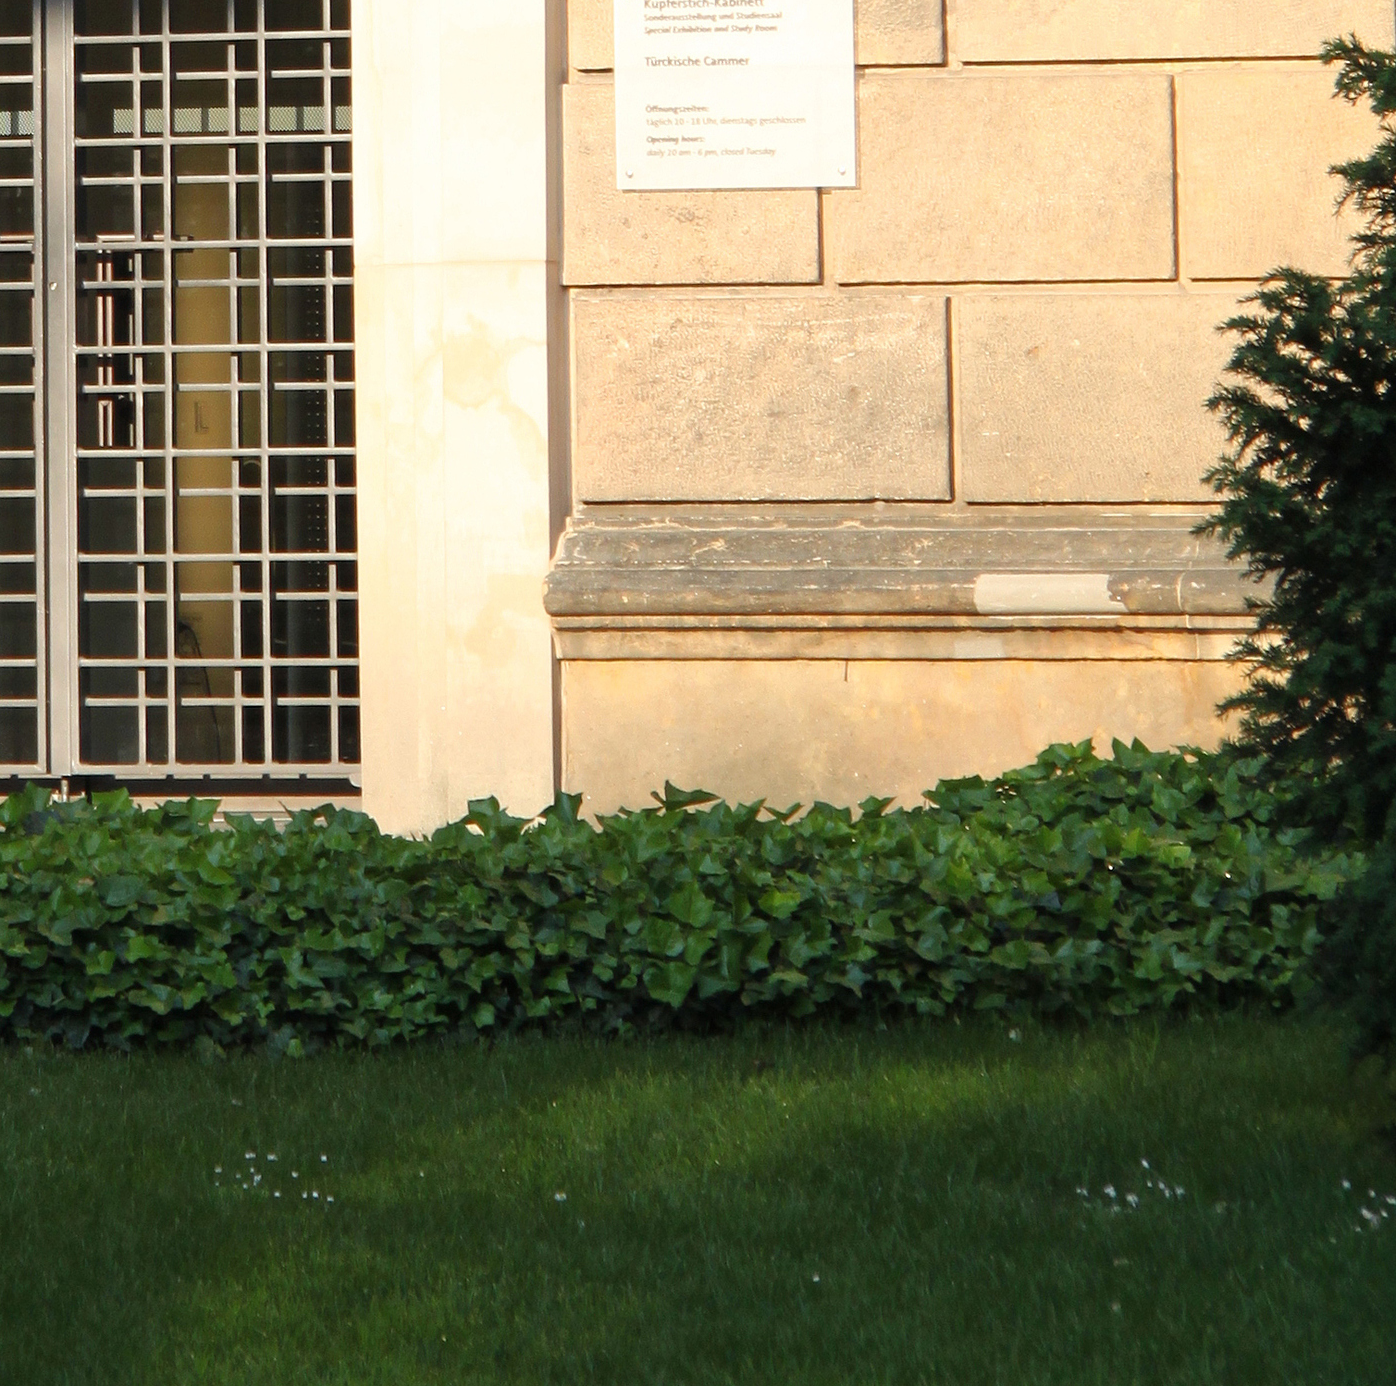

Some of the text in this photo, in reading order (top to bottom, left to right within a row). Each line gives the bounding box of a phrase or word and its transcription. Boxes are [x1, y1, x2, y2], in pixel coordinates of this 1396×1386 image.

[719, 12, 734, 20] und
[714, 25, 729, 33] and
[731, 24, 753, 34] Study
[644, 55, 750, 67] Türckische Cammer
[759, 116, 807, 127] geschlossen
